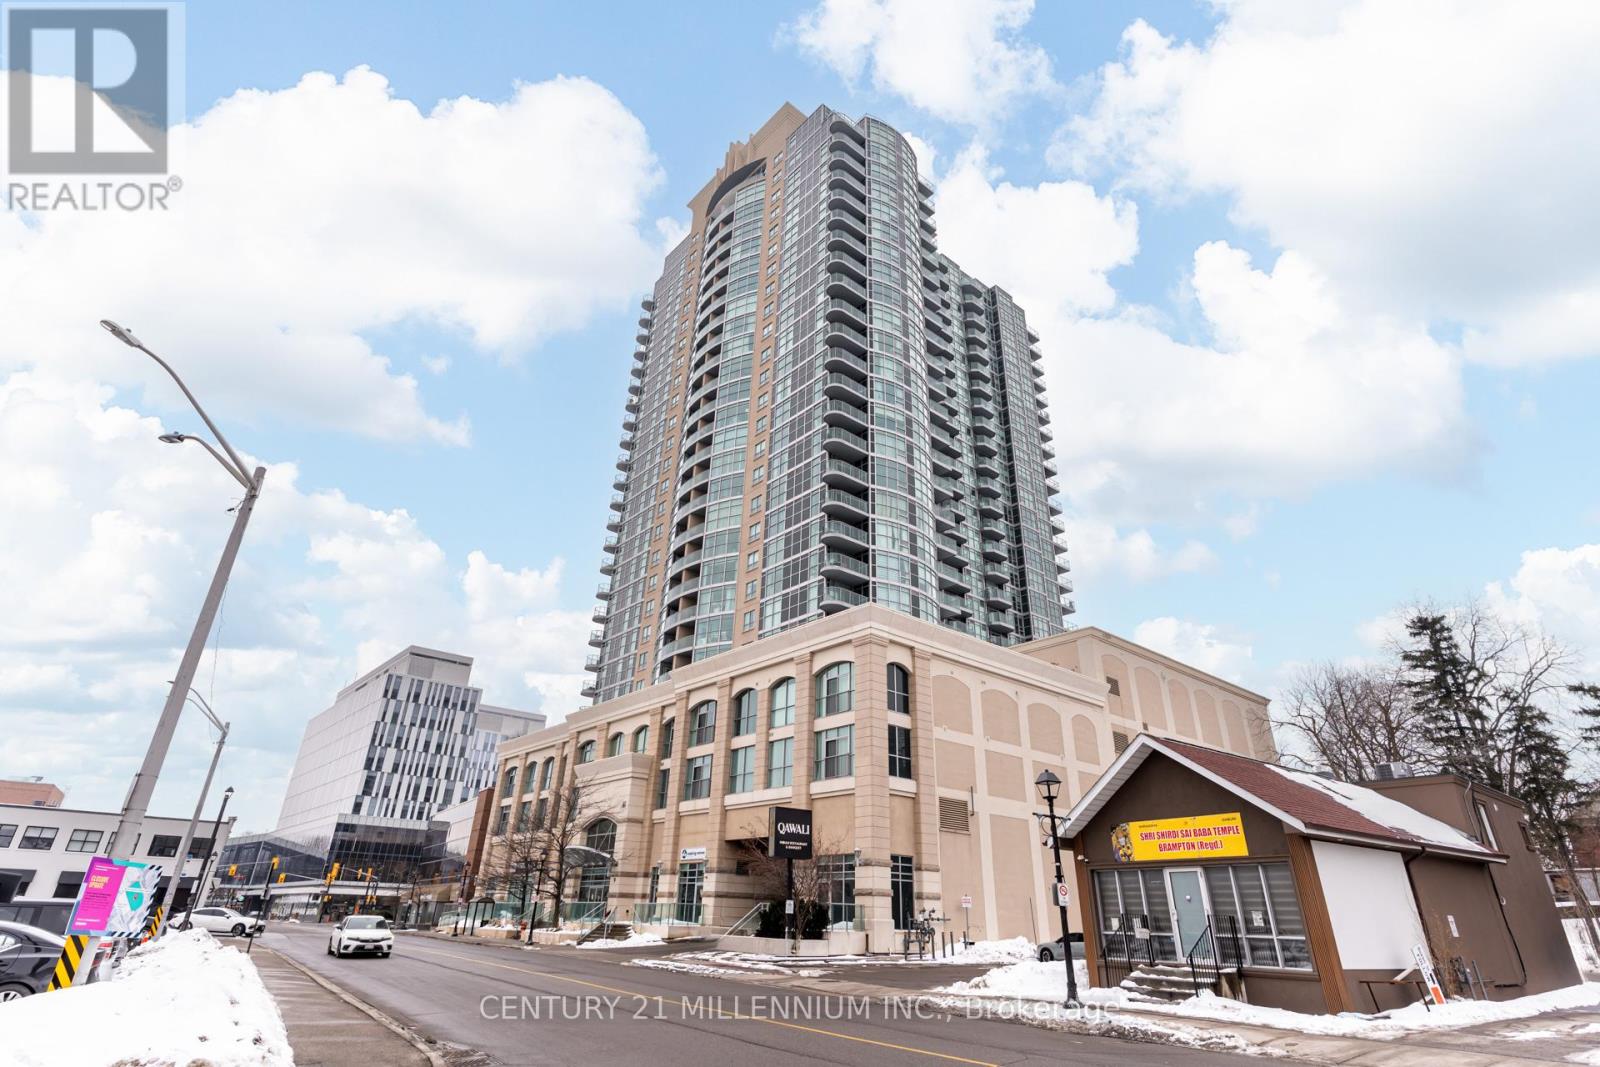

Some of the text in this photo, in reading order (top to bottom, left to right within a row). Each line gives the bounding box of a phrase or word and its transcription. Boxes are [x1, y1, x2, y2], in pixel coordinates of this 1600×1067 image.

[777, 822, 810, 835] QAWALI
[1140, 825, 1240, 841] SHRI SHIRDI SAI BABA TEMPLE
[1158, 841, 1196, 852] BRAMPTON
